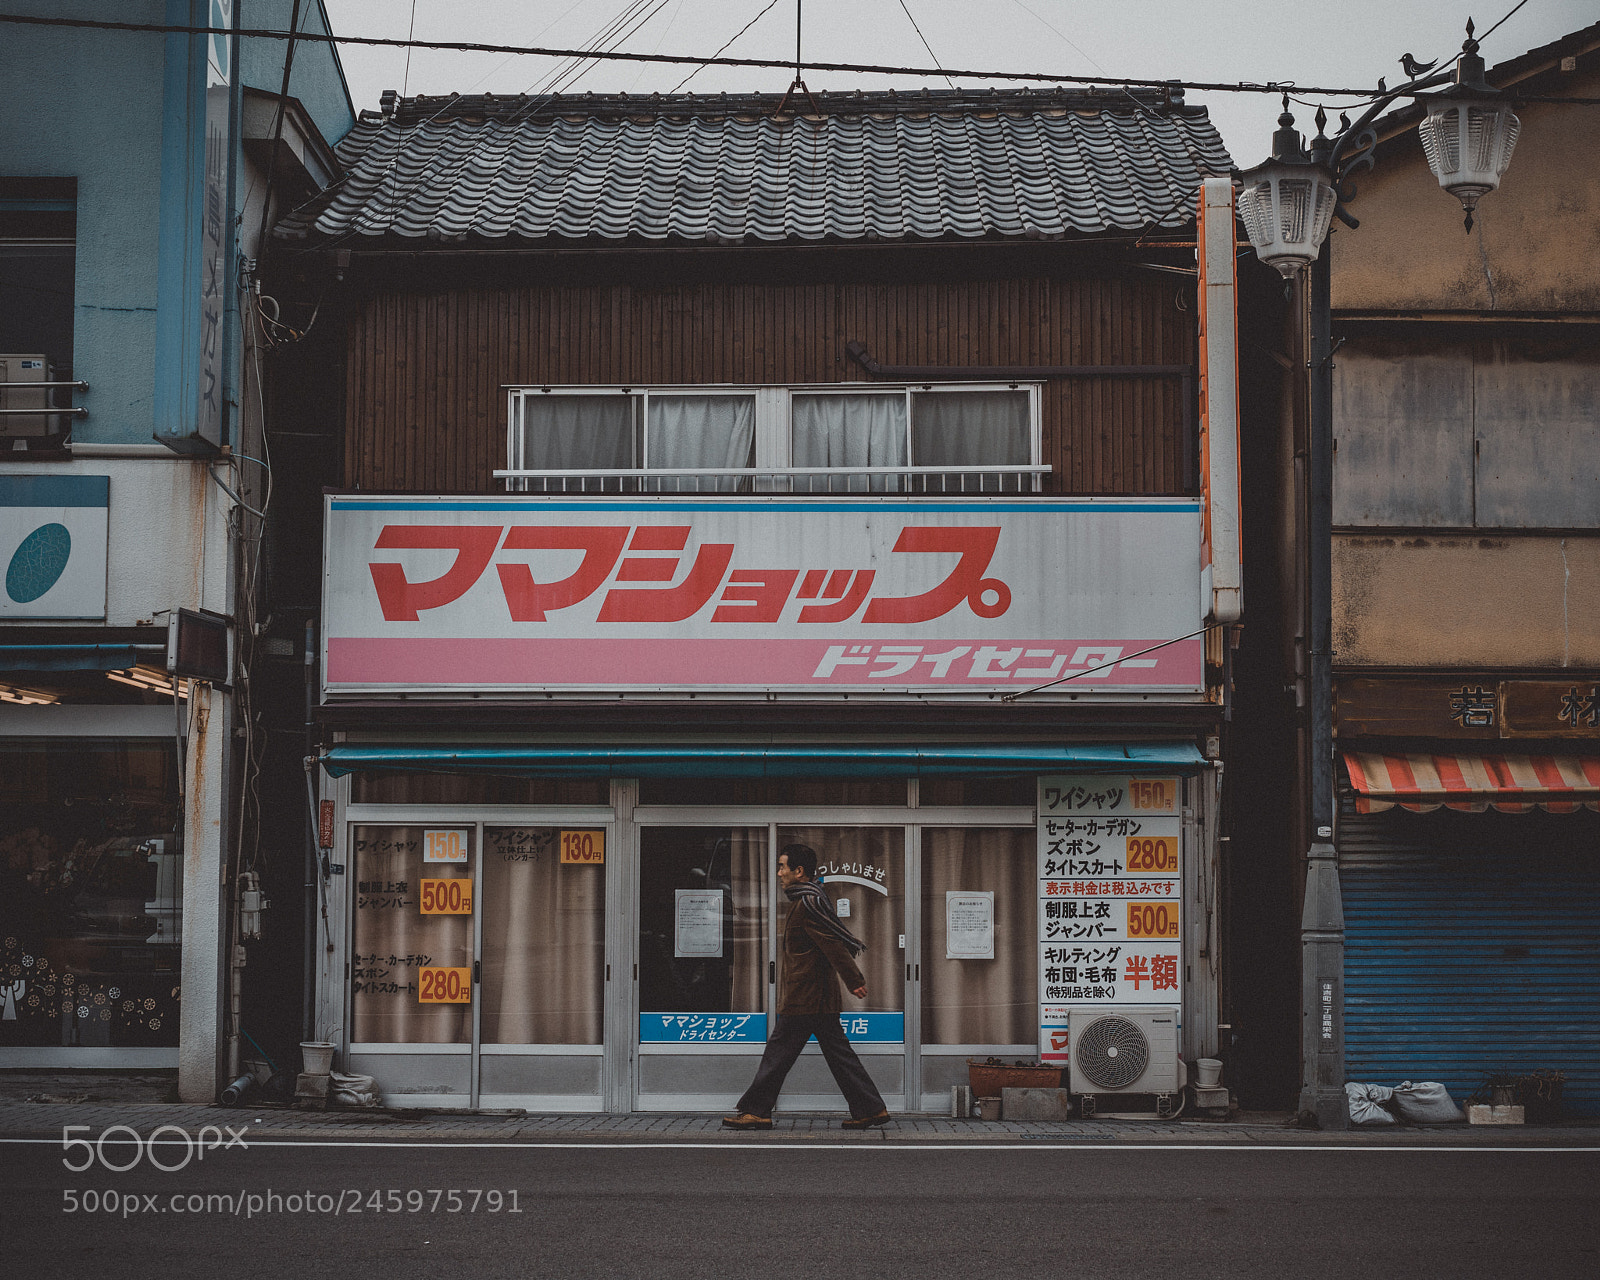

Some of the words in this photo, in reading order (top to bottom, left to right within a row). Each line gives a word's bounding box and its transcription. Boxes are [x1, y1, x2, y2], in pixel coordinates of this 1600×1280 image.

[369, 525, 1012, 624] ママショップ
[812, 645, 1158, 679] ドライセンター
[1448, 686, 1497, 727] 若
[1045, 786, 1123, 810] ワイシャツ
[1131, 781, 1173, 809] 150円
[1046, 818, 1142, 836] セーター・カーデガン
[426, 832, 466, 859] 150円
[563, 833, 602, 861] 130円
[1047, 838, 1101, 856] ズボン
[1128, 839, 1177, 869] 280円
[814, 861, 886, 882] っしゃいませ
[1044, 858, 1123, 876] タイトスカート
[423, 882, 471, 911] 500円
[1046, 881, 1175, 896] 表示料金は税込みです
[1045, 902, 1111, 919] 制服上衣
[1129, 905, 1178, 935] 500円
[1044, 946, 1122, 963] キルティング
[353, 968, 389, 979] ズボン
[1045, 966, 1117, 984] 布団・毛布
[1124, 954, 1179, 991] 半額
[421, 970, 470, 1000] 280円
[1046, 986, 1115, 999] (特別品を除く)
[661, 1015, 751, 1029] ママショップ
[679, 1029, 747, 1041] ドライセンター
